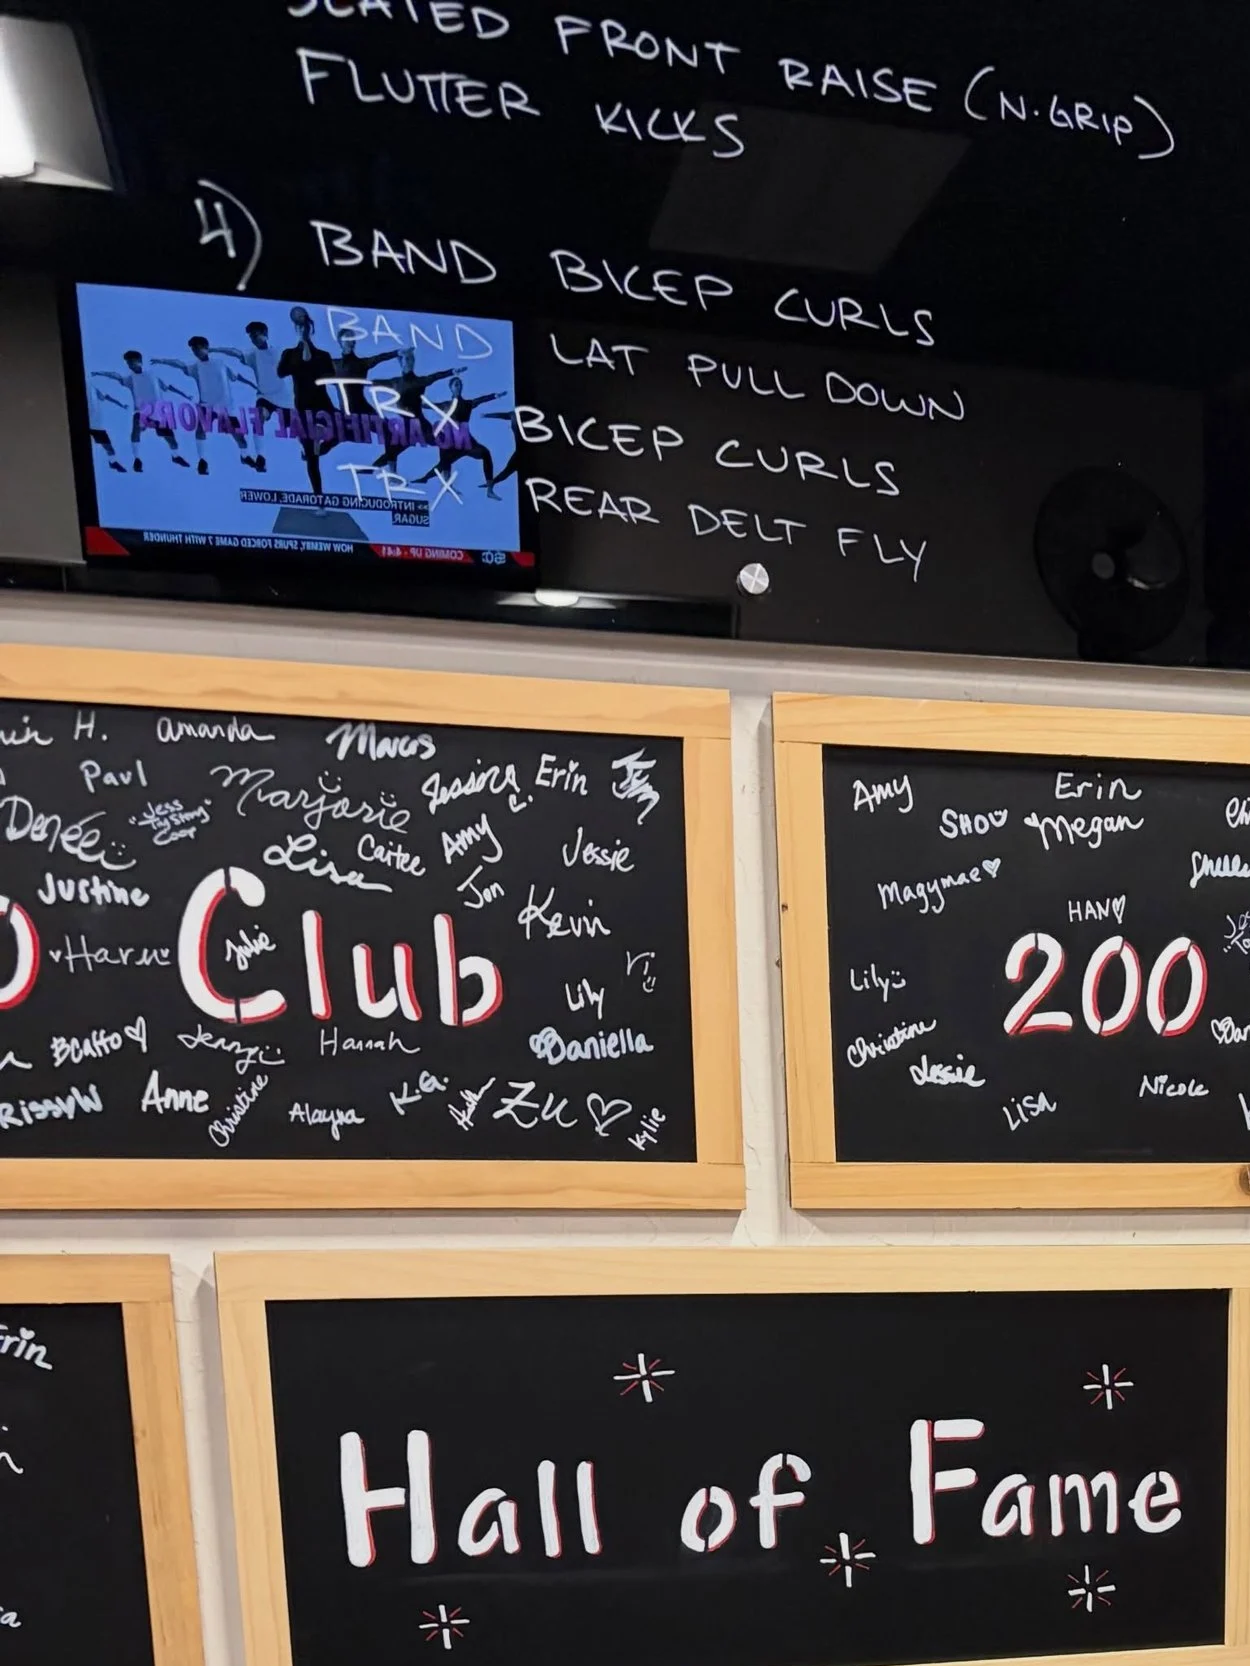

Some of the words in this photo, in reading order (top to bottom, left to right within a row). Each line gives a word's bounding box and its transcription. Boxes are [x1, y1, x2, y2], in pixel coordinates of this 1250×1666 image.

[555, 15, 740, 75] FRONT
[778, 57, 938, 114] RAISE
[296, 47, 541, 120] FLUTTER
[595, 101, 747, 158] KICKS
[309, 219, 497, 285] BAND
[549, 249, 733, 312] BICEP
[774, 288, 935, 347] CURLS
[326, 304, 494, 361] BAND
[549, 332, 650, 377] LAT
[687, 353, 805, 399] PULL
[826, 370, 966, 422] DOWN
[314, 377, 461, 437] TRX
[513, 402, 684, 460] BICEP
[714, 437, 901, 498] CURLS
[337, 462, 464, 513] TRX
[525, 477, 661, 526] REAR
[689, 503, 808, 550] DELT
[837, 527, 928, 583] FLY
[74, 710, 108, 741] H.
[79, 759, 148, 793] Paul
[534, 753, 588, 796] Erin
[852, 773, 914, 814] Amy
[1055, 771, 1142, 801] Erin
[209, 765, 410, 834] Marjorie
[441, 812, 503, 865] Amy
[562, 826, 635, 873] Jessie
[1032, 812, 1145, 851] Megan
[262, 833, 394, 893] Lisa
[38, 871, 151, 909] Justine
[517, 884, 612, 940] Kevin
[1067, 897, 1112, 923] HAN
[177, 866, 504, 1026] Club
[564, 978, 606, 1020] Lily
[1002, 931, 1209, 1037] 200
[319, 1026, 421, 1056] Hannah
[530, 1026, 655, 1066] Daniella
[141, 1070, 210, 1114] Anne
[1138, 1073, 1210, 1100] Nicole
[627, 1105, 667, 1151] Kylie
[0, 1323, 53, 1371] rin
[339, 1429, 603, 1569] Hall
[680, 1451, 812, 1554] of
[908, 1418, 1183, 1545] Fame
